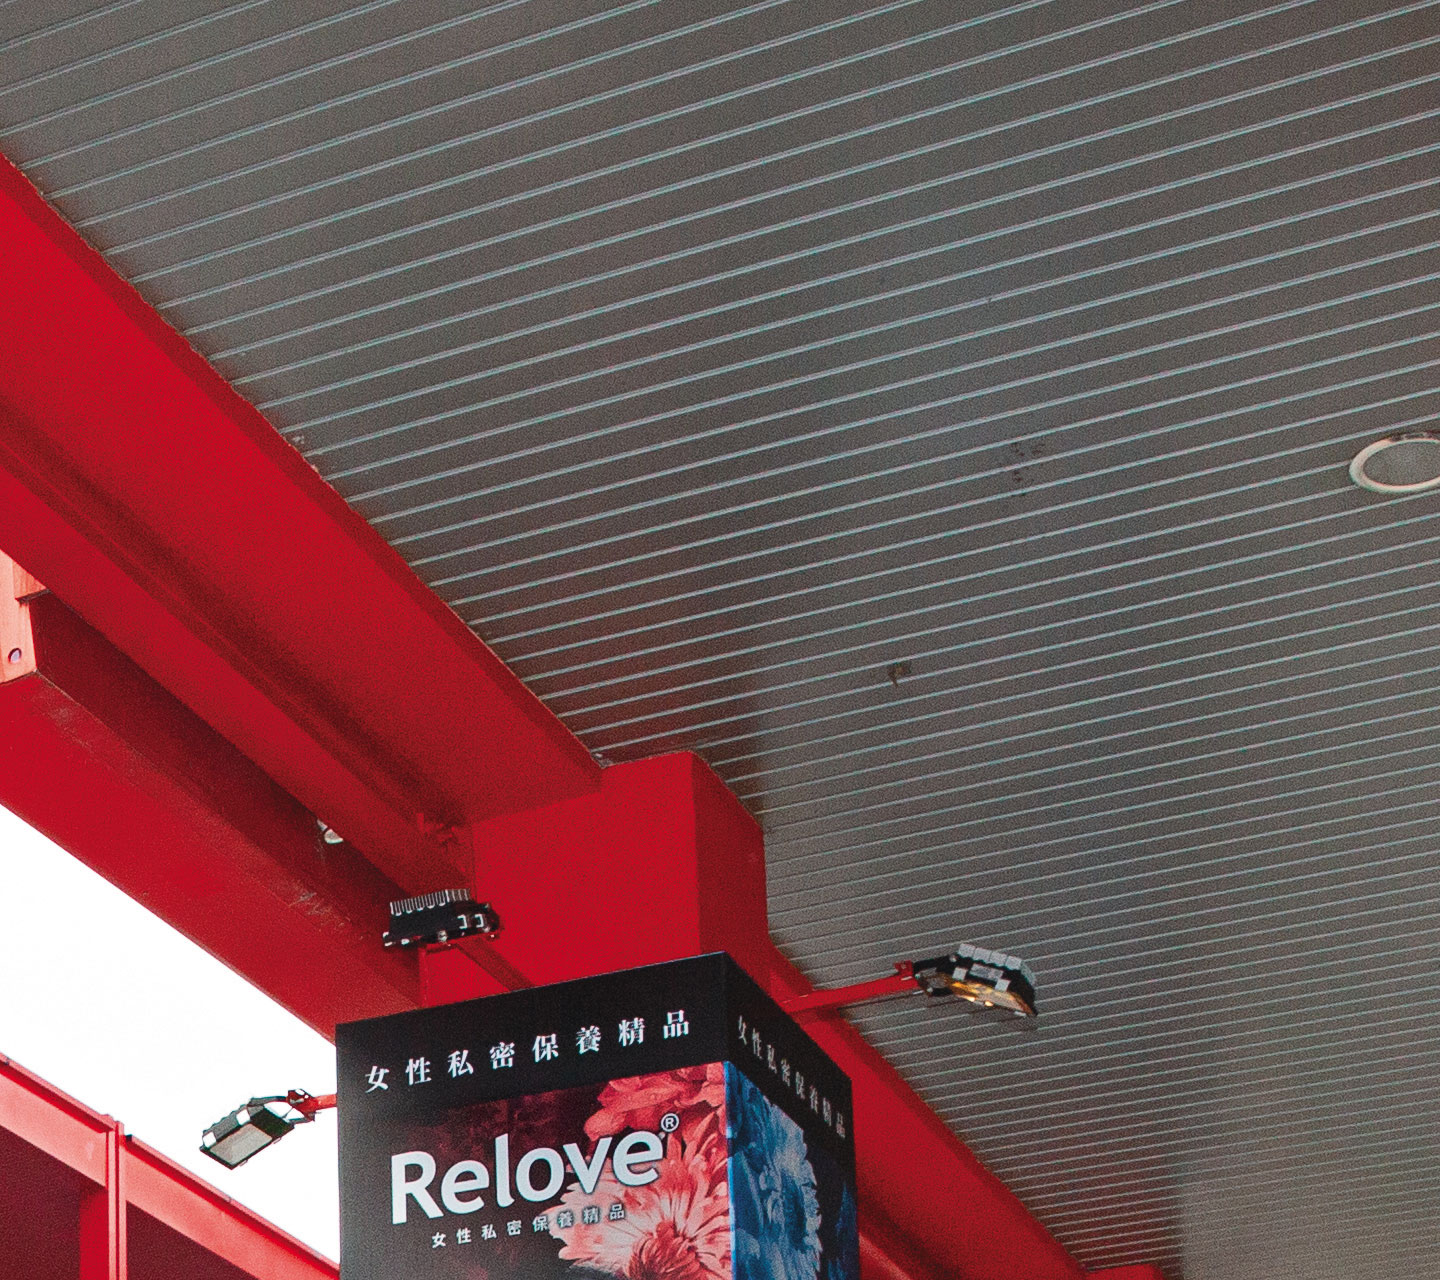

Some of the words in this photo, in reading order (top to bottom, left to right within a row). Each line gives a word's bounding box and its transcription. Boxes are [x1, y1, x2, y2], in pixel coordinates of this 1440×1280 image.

[365, 1010, 691, 1093] 女性私密保養精品
[432, 1203, 626, 1248] 女性私密保養精品
